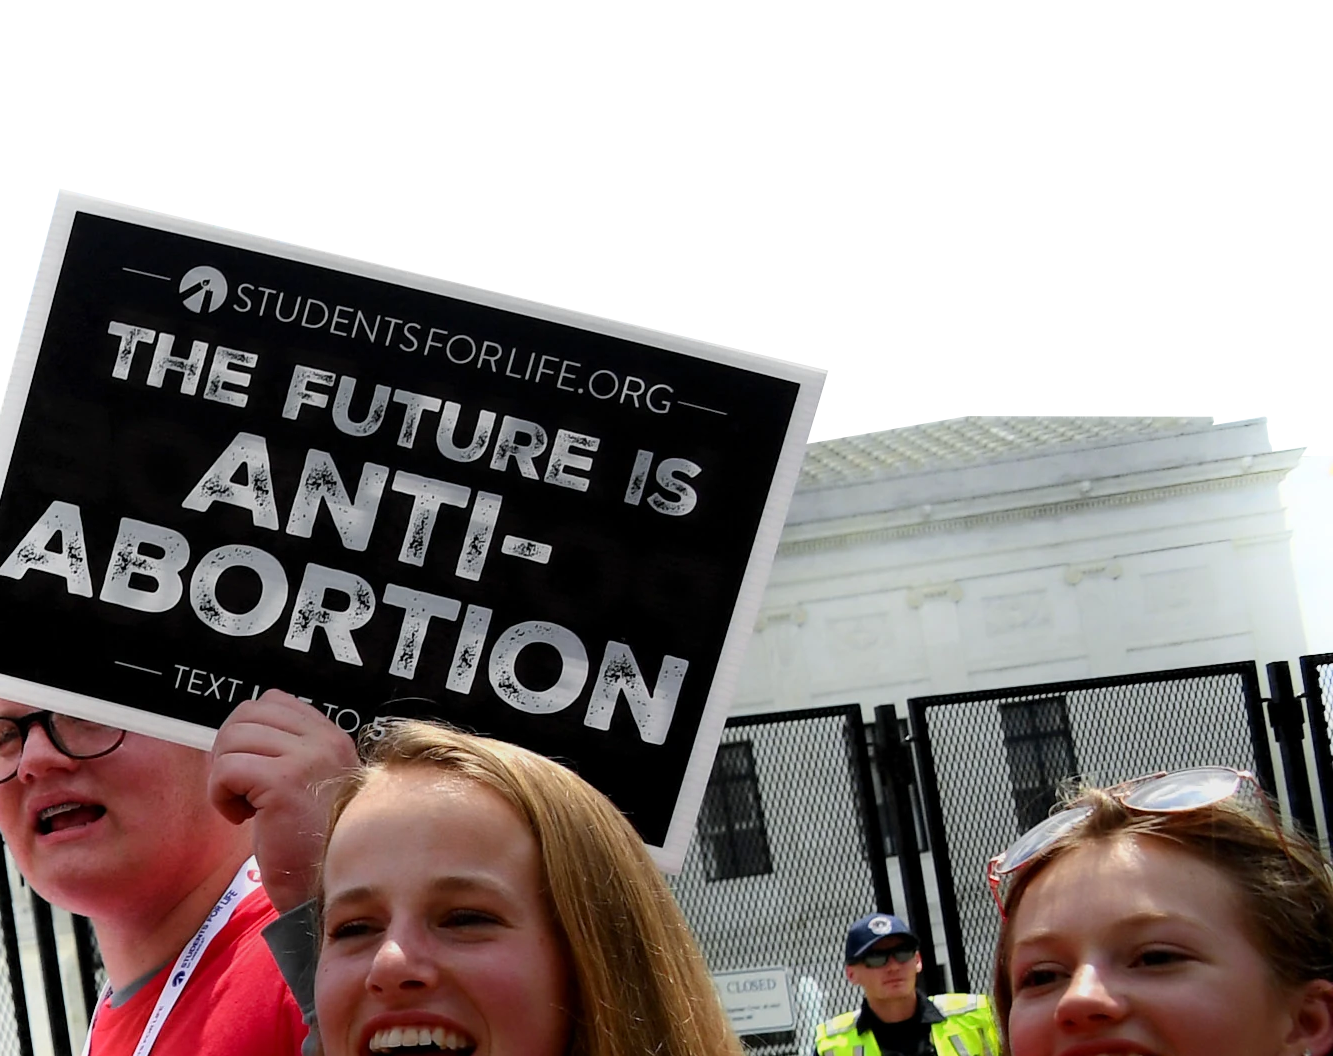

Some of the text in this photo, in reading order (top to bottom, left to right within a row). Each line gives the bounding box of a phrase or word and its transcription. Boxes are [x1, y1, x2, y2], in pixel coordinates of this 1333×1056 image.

[232, 282, 676, 416] STUDENTSFORLIFE.ORG
[107, 320, 703, 517] THE FUTURE IS
[182, 432, 553, 582] ANTI-
[174, 664, 243, 702] TEXT
[323, 702, 361, 733] TO
[726, 978, 777, 995] CLOSED
